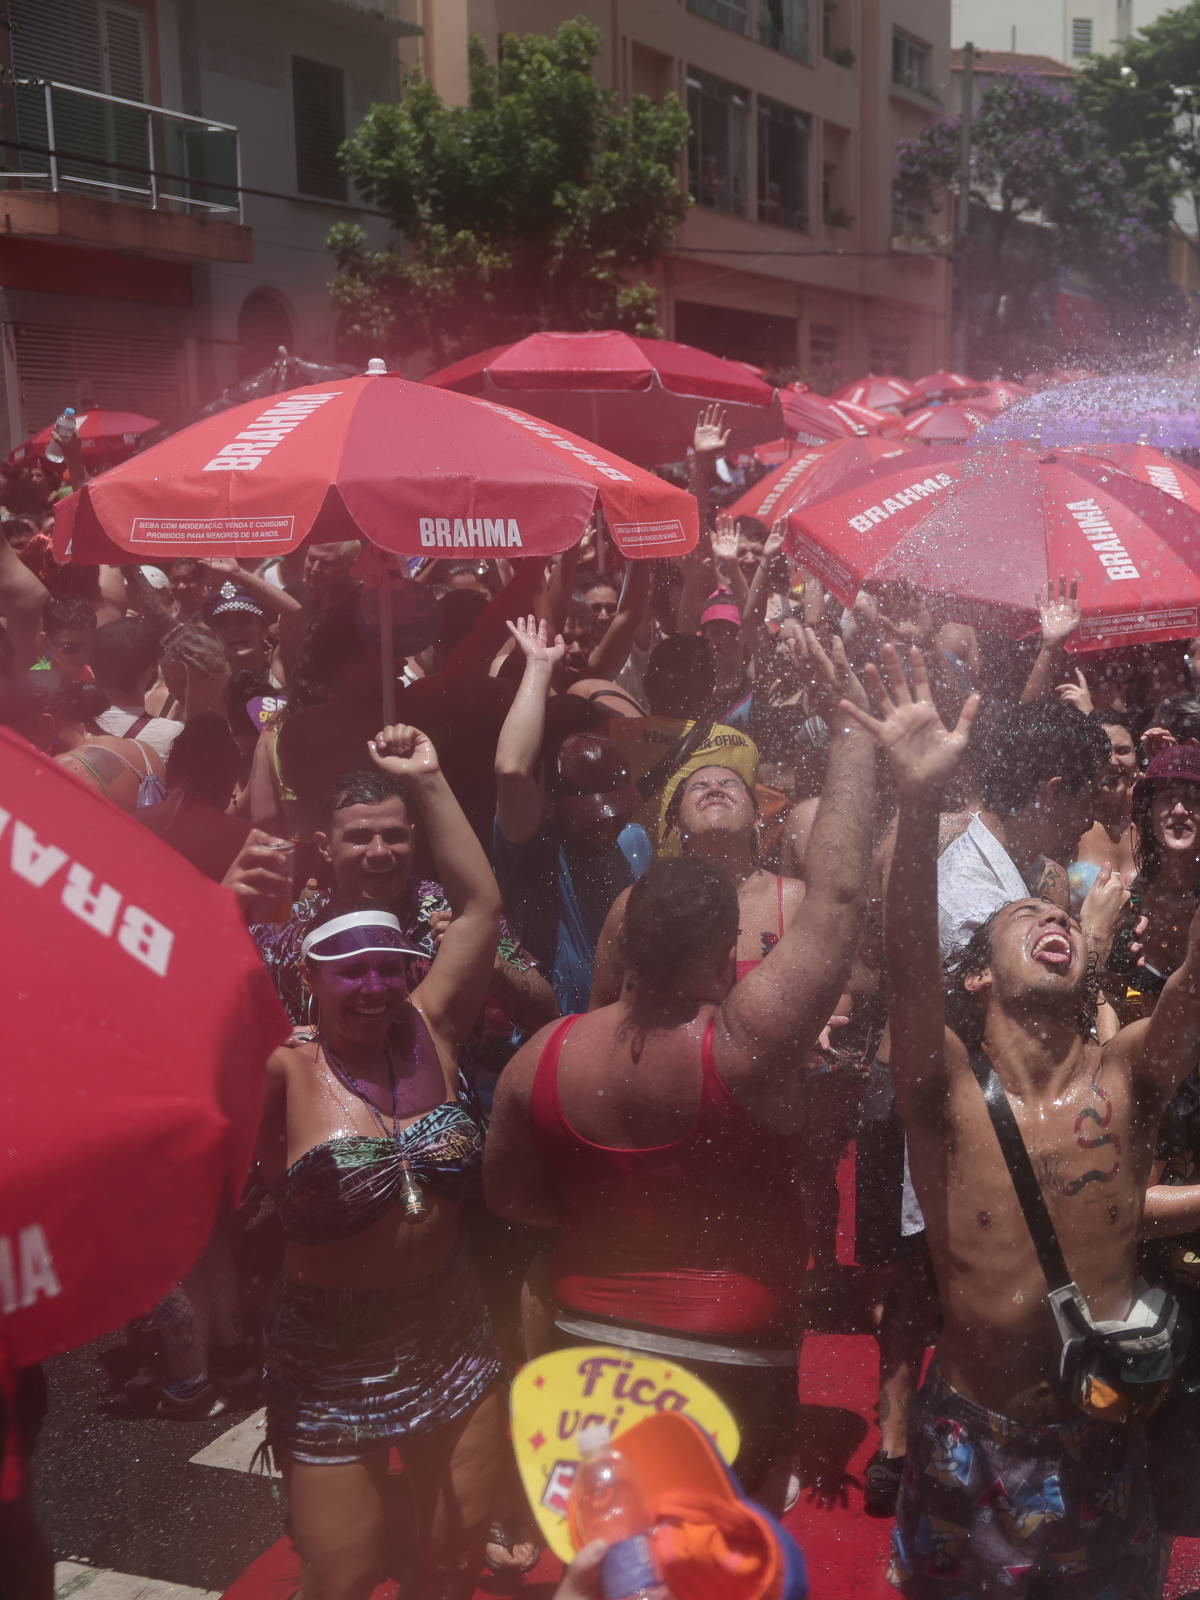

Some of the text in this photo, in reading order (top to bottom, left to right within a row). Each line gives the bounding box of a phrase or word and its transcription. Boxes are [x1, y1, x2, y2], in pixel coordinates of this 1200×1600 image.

[202, 392, 344, 471] BRAHMA
[757, 453, 824, 516] BRAHMA
[850, 472, 951, 533] BRAHMA
[186, 531, 205, 539] PARA
[206, 531, 239, 539] MENORES
[255, 520, 288, 528] CONSUMO
[419, 517, 523, 547] BRAHMA
[1066, 498, 1141, 580] BRAHMA
[577, 1357, 690, 1413] Fica
